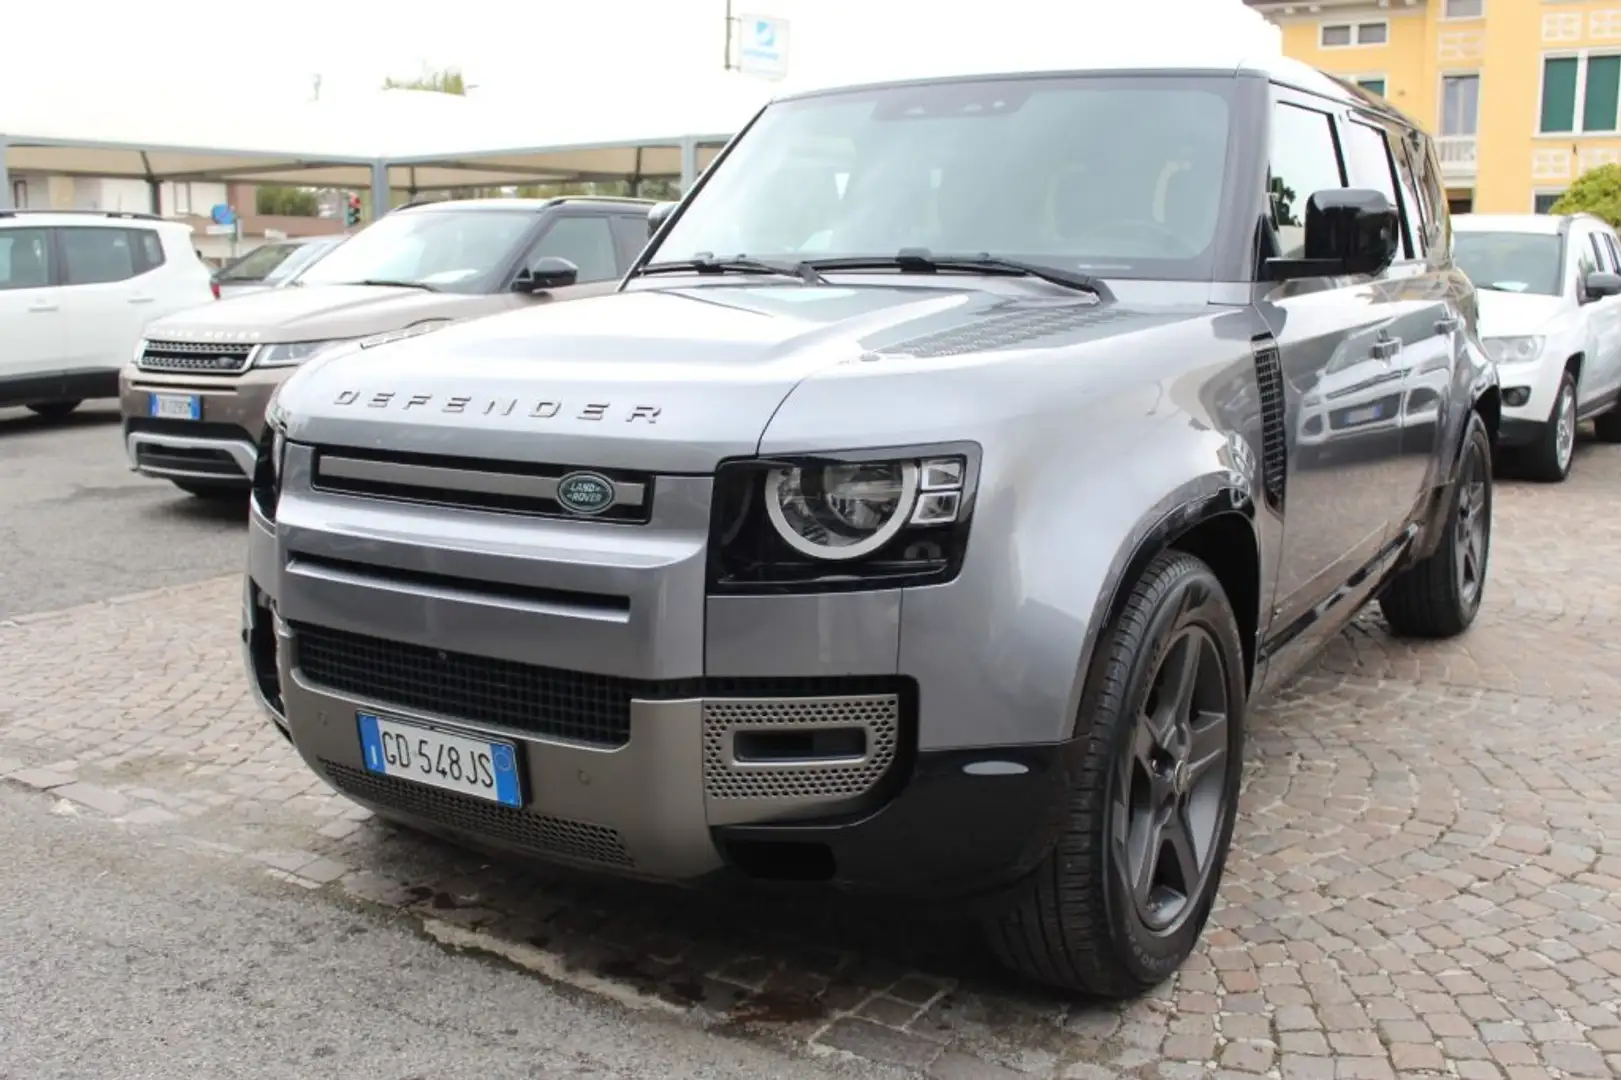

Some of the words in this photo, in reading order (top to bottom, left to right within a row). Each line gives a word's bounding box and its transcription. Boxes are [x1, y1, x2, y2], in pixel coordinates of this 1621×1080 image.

[334, 390, 662, 423] DEFENDER
[569, 482, 595, 493] LAND
[571, 492, 602, 502] ROVER
